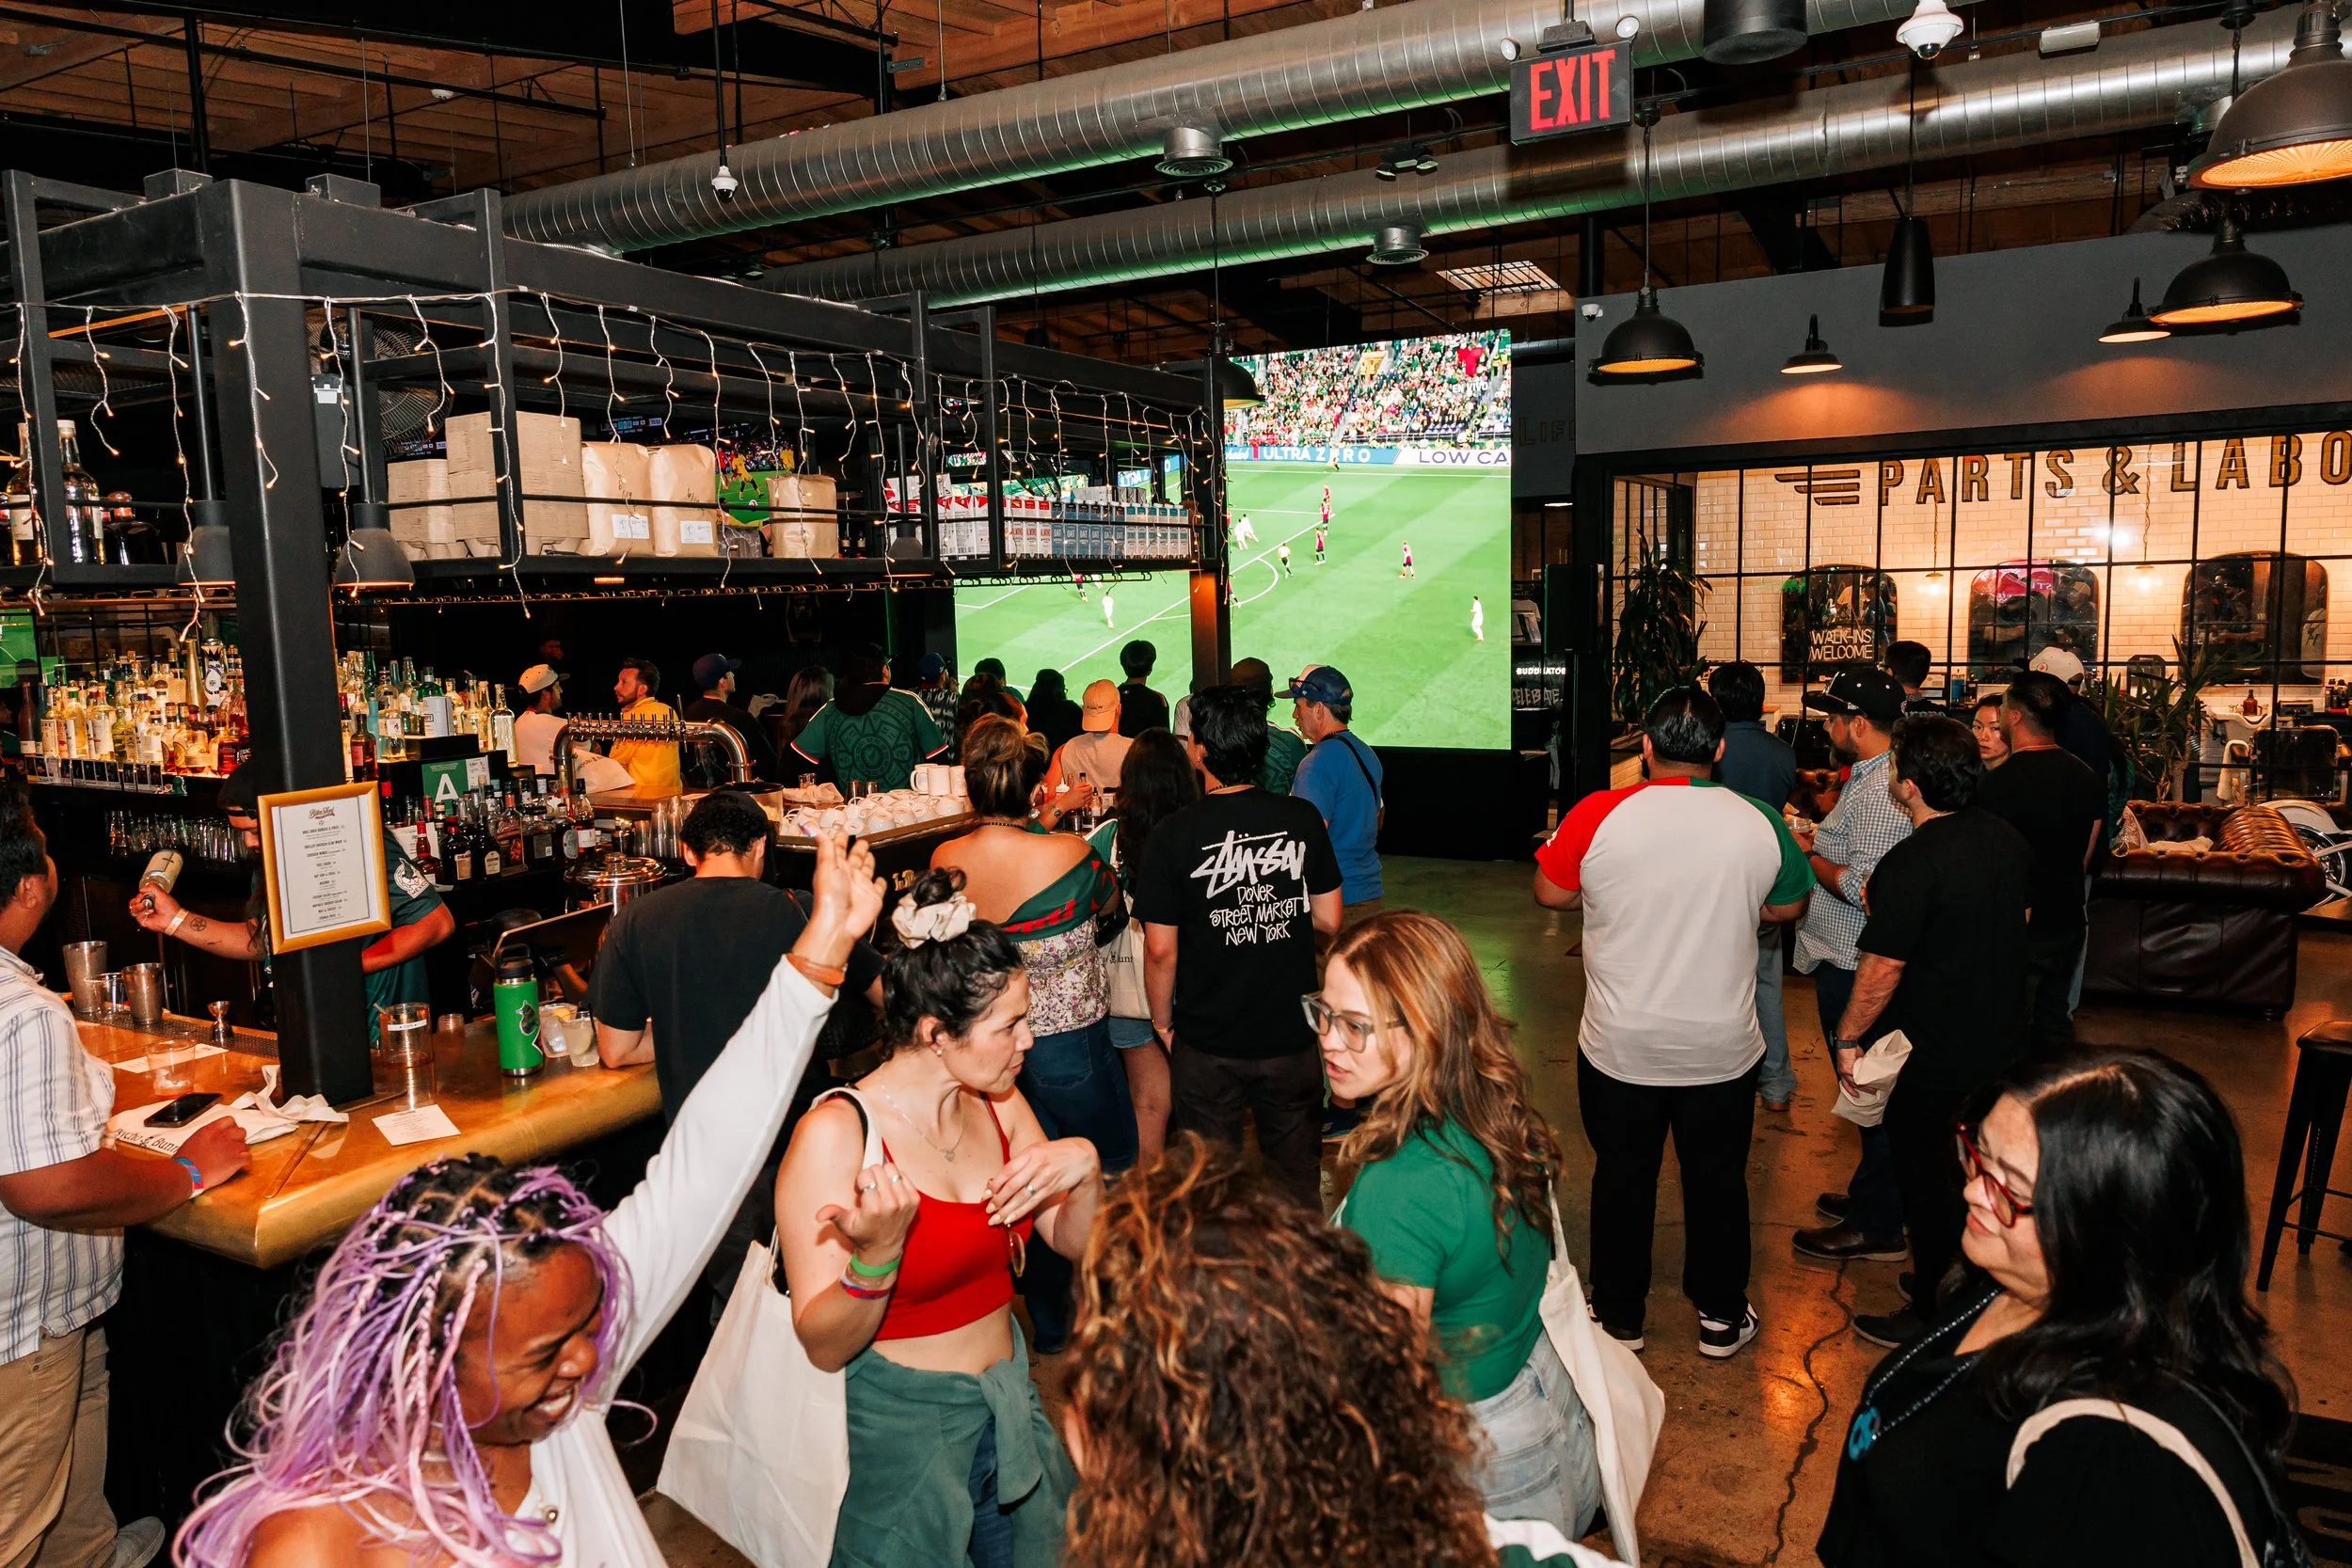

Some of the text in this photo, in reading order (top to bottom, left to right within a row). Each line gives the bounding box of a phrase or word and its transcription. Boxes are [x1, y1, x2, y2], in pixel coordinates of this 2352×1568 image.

[1530, 49, 1615, 131] EXIT
[1263, 446, 1311, 461] ULTRA
[1315, 446, 1372, 462] ZRO
[1419, 451, 1472, 465] LOW
[1882, 449, 2074, 506] PARTS
[2102, 446, 2140, 495] &
[1810, 628, 1872, 644] WALK-INS
[1810, 644, 1873, 660] WELCOME
[433, 773, 460, 807] A
[1237, 884, 1277, 905] DOVER
[1209, 896, 1304, 927] STREET MARKET
[1226, 920, 1291, 945] NEW YORK
